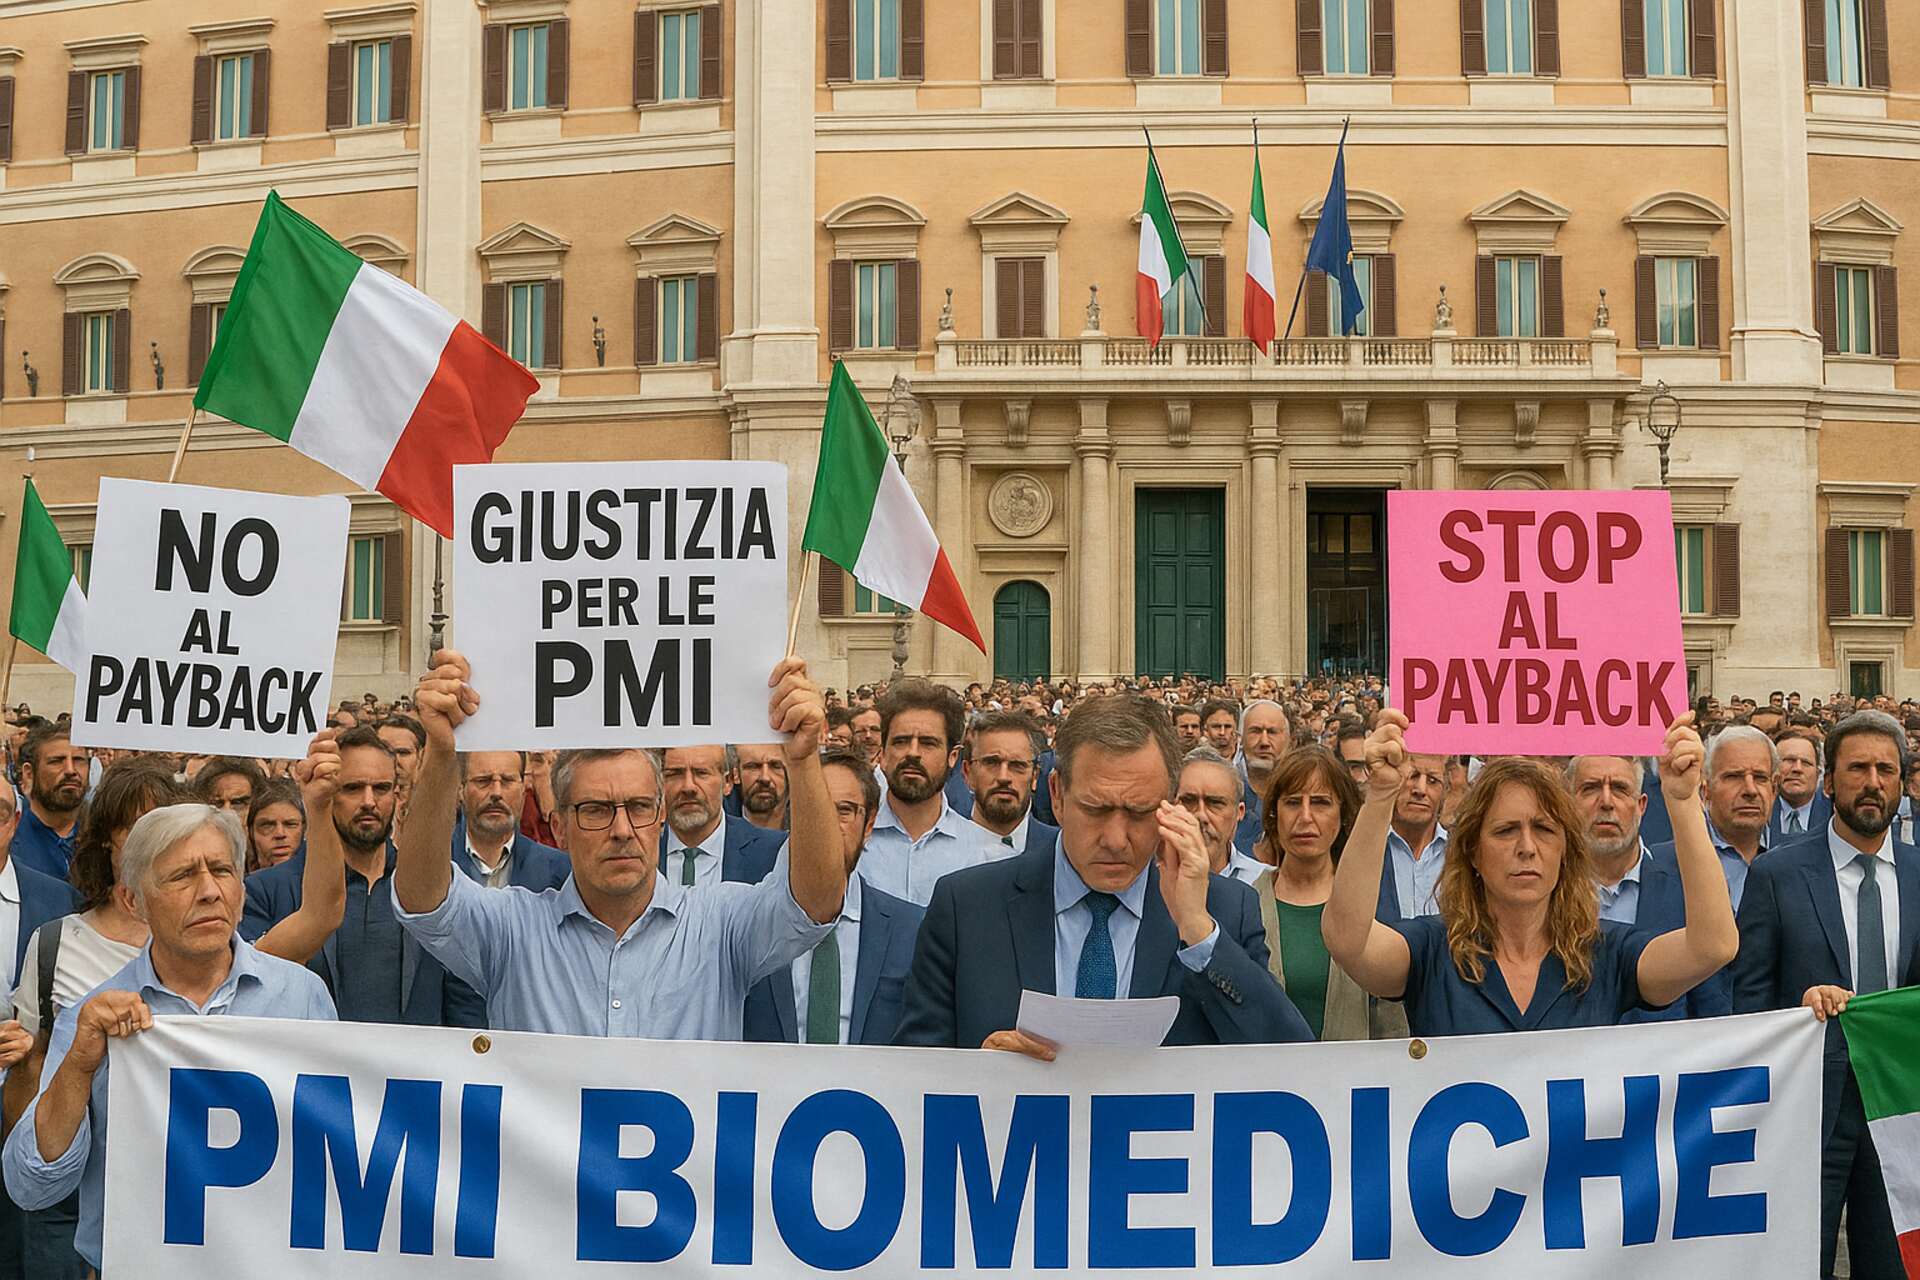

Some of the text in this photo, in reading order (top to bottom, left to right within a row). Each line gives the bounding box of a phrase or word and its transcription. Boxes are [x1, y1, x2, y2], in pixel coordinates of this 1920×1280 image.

[154, 508, 280, 597] NO
[470, 487, 777, 564] GIUSTIZIA
[1437, 509, 1643, 585] STOP
[179, 608, 240, 656] AL
[541, 575, 716, 630] PER LE
[1497, 590, 1578, 651] AL
[84, 654, 323, 735] PAYBACK
[535, 638, 712, 728] PMI
[1402, 657, 1676, 731] PAYBACK
[163, 1065, 1770, 1271] PMI BIOMEDICHE
